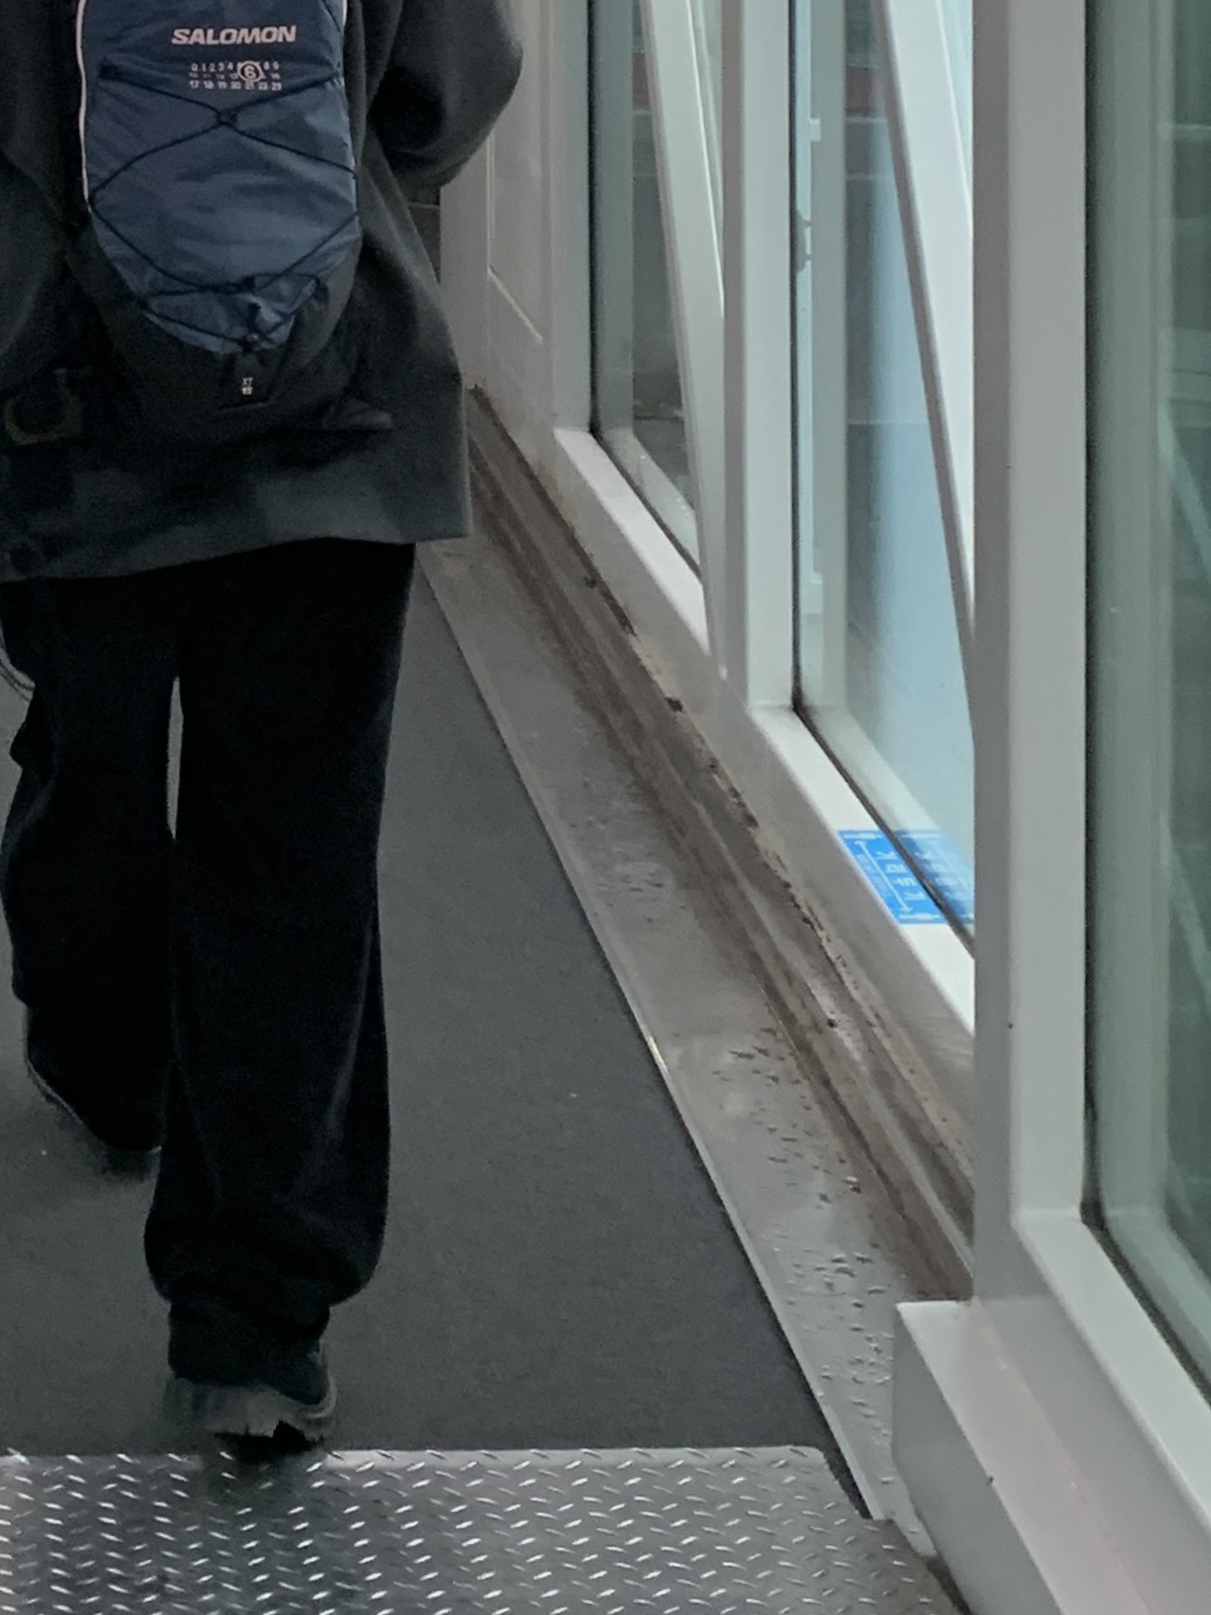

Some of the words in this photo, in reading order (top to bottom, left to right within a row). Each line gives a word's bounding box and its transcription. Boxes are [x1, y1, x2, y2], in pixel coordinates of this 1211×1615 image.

[171, 25, 297, 45] SALOMON
[218, 61, 225, 72] 3
[227, 61, 234, 70] 4
